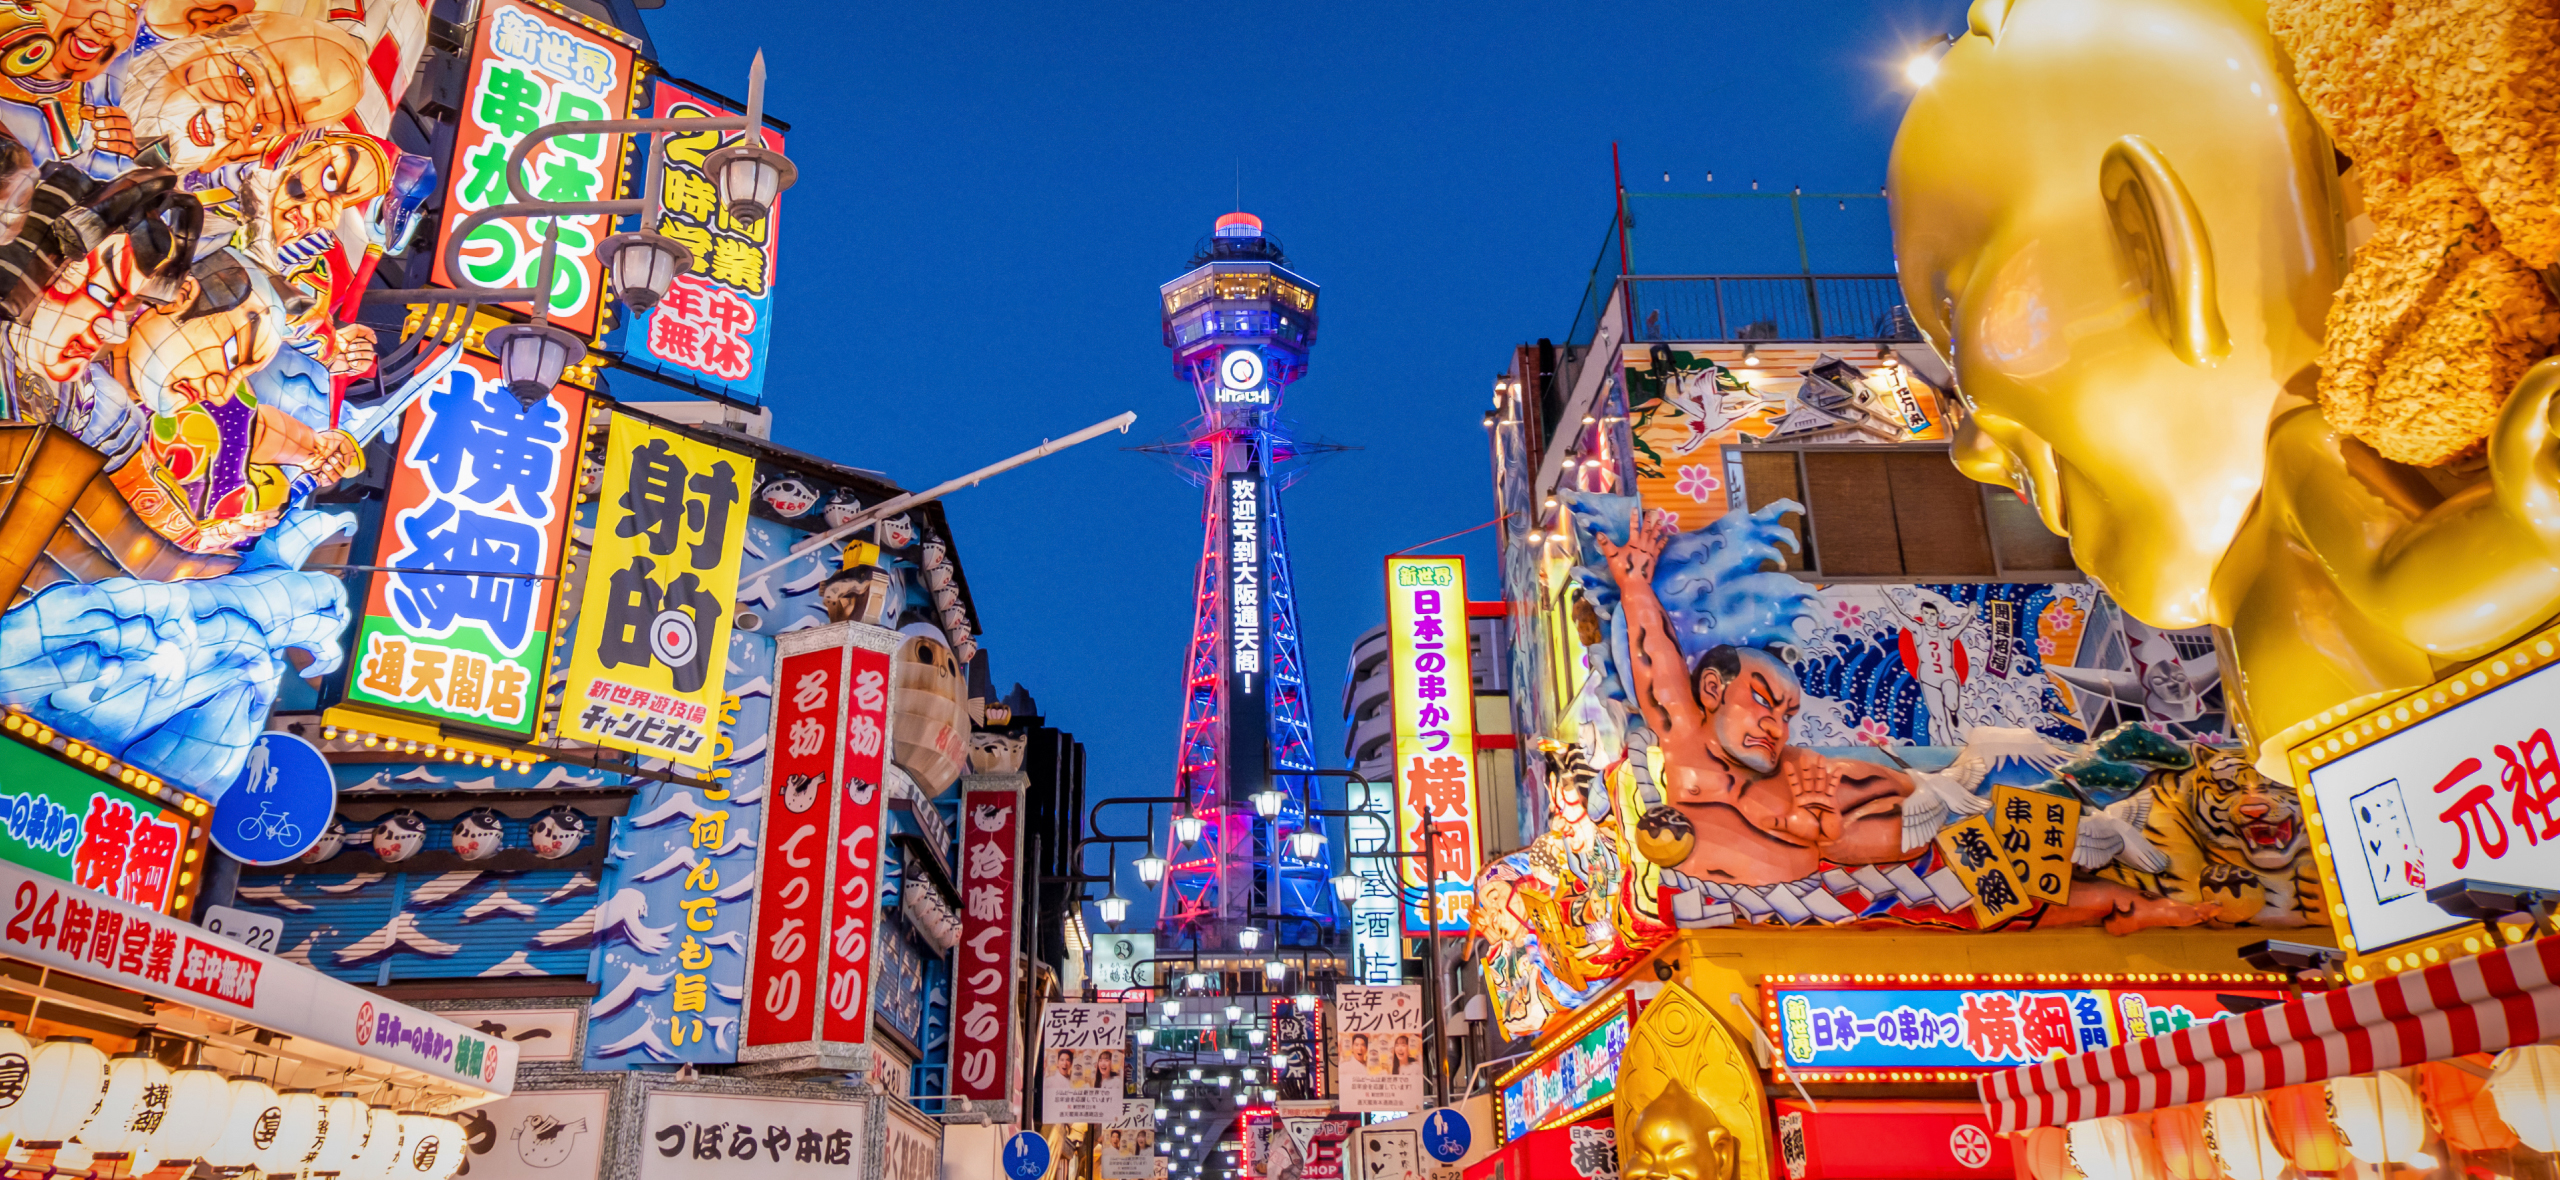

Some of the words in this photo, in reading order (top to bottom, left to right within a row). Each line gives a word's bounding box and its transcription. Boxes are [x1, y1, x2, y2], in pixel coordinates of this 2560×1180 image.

[499, 10, 612, 92] 新世界
[459, 66, 542, 283] 串かつ
[526, 92, 602, 309] 日本一の
[661, 284, 750, 334] 年中
[655, 314, 746, 373] 無休
[1215, 387, 1269, 404] HITACHI
[393, 370, 562, 650] 横綱
[597, 438, 740, 693] 射的
[1400, 566, 1453, 586] 新世界
[368, 637, 527, 719] 通天閣店
[1414, 590, 1450, 752] 日本一の串かつ
[582, 705, 704, 753] チャンピオン
[588, 680, 707, 724] 新世界遊技場
[787, 669, 829, 759] 名物
[850, 669, 884, 758] 名物
[1408, 754, 1473, 884] 横綱
[2433, 728, 2560, 870] 元祖
[75, 796, 178, 915] 横綱
[2002, 797, 2032, 883] 串かつ
[2039, 804, 2065, 895] 日本一の
[1951, 827, 2019, 917] 横綱
[6, 880, 177, 985] 24時間営業
[184, 943, 255, 1001] 年中無休
[1339, 990, 1384, 1011] 忘年
[375, 1013, 453, 1063] 日本一の串かつ
[1047, 1008, 1090, 1028] 忘年
[1787, 999, 1812, 1060] 新世界
[1813, 1006, 1959, 1047] 日本一の串かつ
[1963, 995, 2077, 1057] 横綱
[2075, 997, 2107, 1053] 名門
[2122, 997, 2150, 1041] 新世
[454, 1034, 485, 1079] 横綱
[131, 1082, 169, 1135] 横綱
[301, 1105, 329, 1163] 千客万来
[655, 1121, 853, 1165] づぼらや本店
